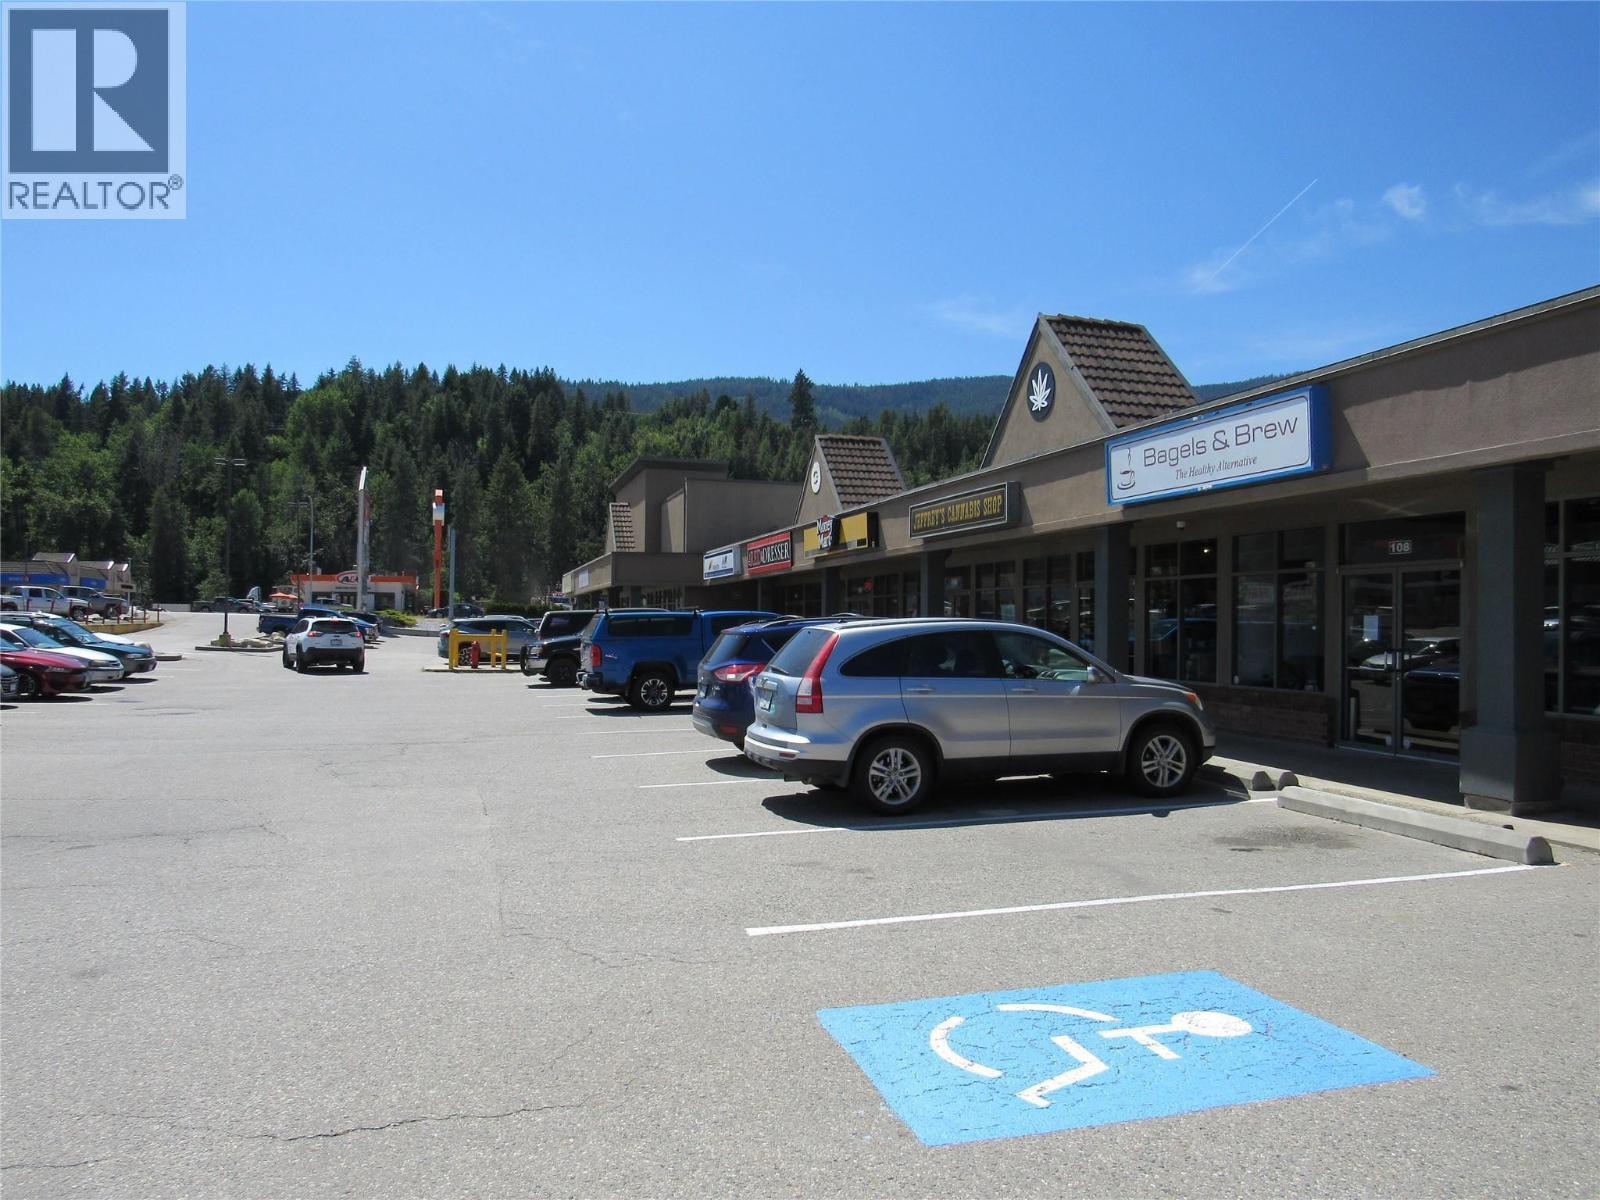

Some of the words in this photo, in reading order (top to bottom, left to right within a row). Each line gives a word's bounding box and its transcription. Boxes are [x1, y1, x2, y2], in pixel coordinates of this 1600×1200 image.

[1143, 437, 1207, 467] Bagels
[1212, 430, 1230, 450] &
[1235, 417, 1298, 445] Brew
[1175, 468, 1188, 480] The
[1189, 462, 1216, 478] Healthy
[1217, 455, 1258, 473] Alternative
[947, 500, 981, 523] CANNABIS
[983, 495, 1003, 516] SHOP
[1391, 542, 1410, 552] 108
